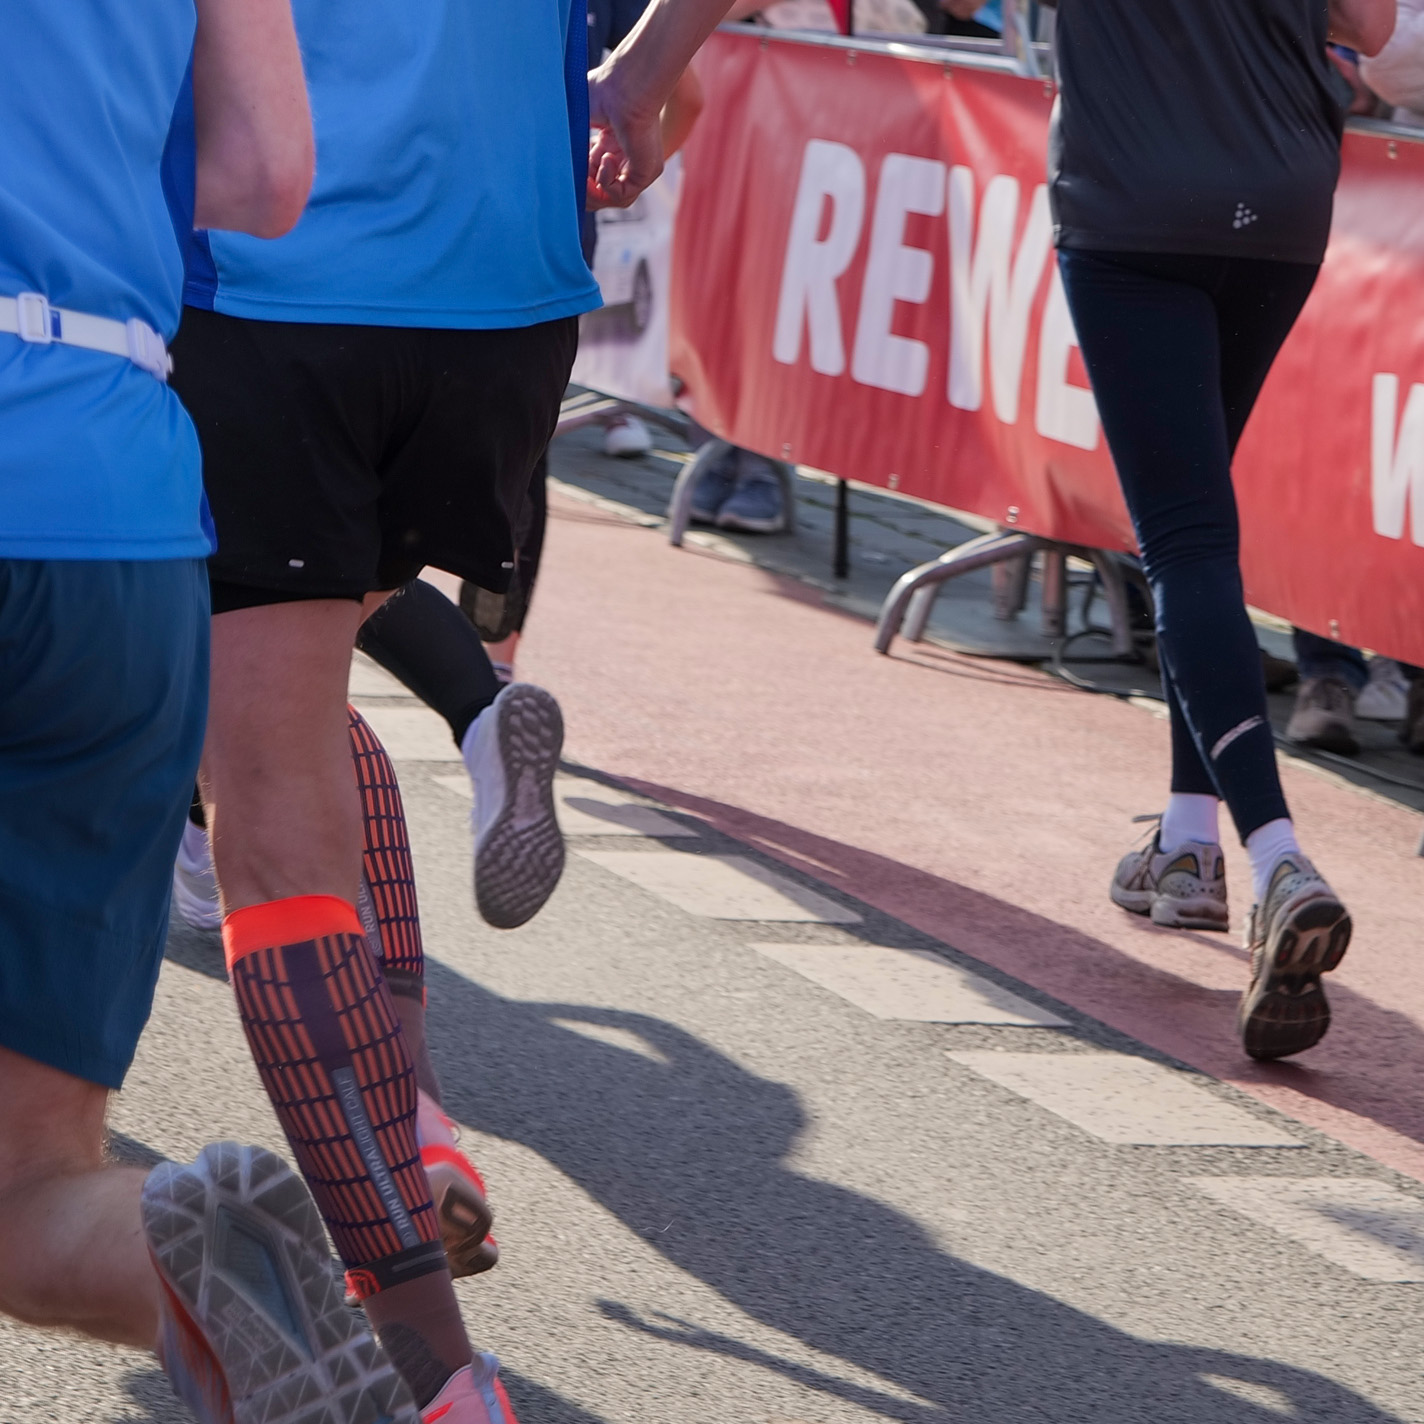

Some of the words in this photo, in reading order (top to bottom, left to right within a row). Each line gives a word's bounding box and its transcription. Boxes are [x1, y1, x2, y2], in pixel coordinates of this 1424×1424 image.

[360, 905, 375, 932] RUN
[350, 1112, 394, 1196] ULTRALIGHT
[387, 1198, 409, 1229] RUN
